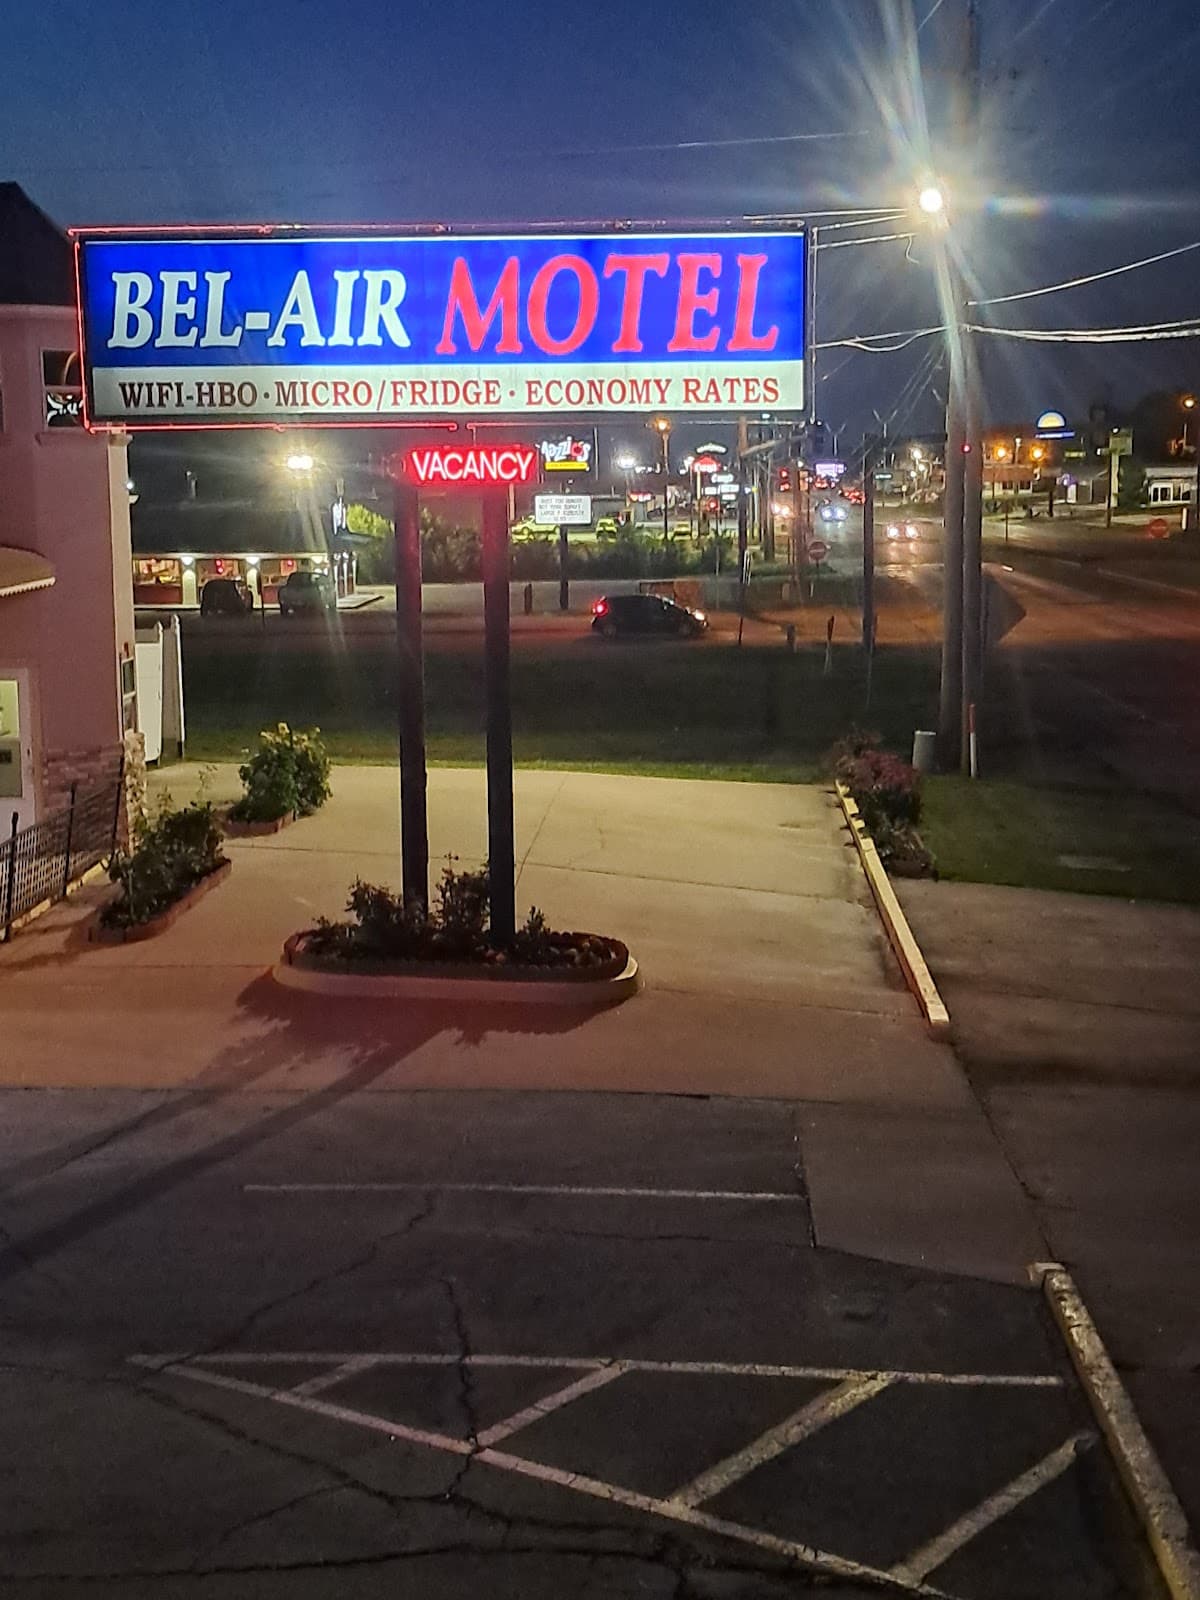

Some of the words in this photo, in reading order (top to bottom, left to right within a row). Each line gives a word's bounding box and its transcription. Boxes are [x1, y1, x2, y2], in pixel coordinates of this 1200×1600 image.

[107, 269, 412, 349] BEL-AIR
[434, 252, 780, 356] MOTEL
[118, 381, 258, 409] WIFI-HBO
[274, 378, 502, 412] MICRO/FRIDGE
[525, 377, 673, 406] ECONOMY
[682, 376, 780, 404] RATES
[411, 451, 534, 481] VACANCY
